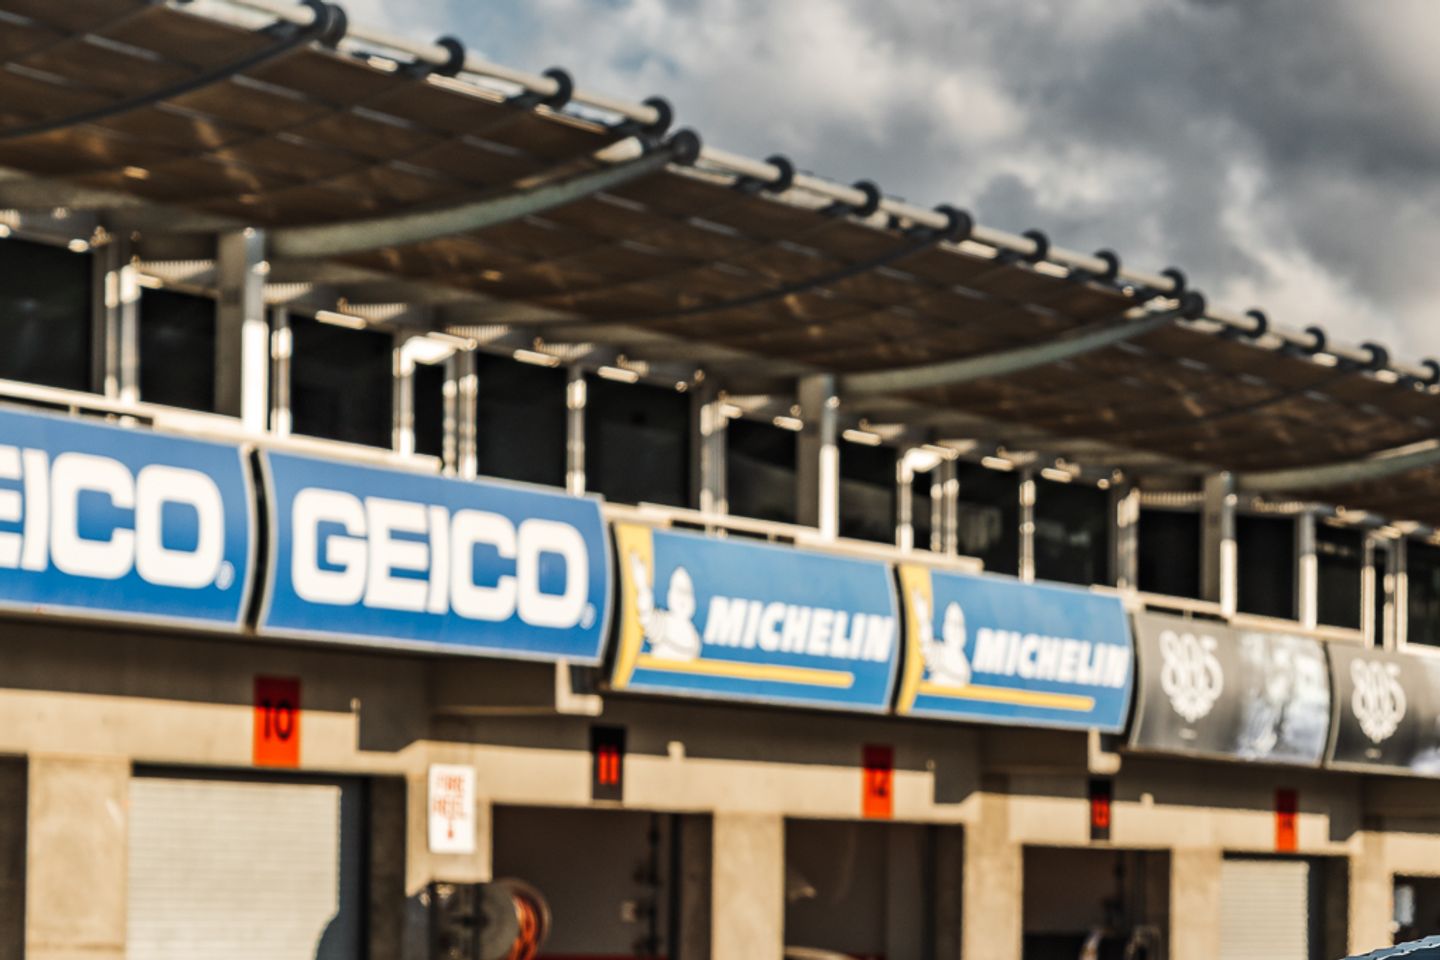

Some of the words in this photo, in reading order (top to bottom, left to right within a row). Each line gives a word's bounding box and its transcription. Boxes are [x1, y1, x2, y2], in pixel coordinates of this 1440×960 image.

[291, 487, 589, 628] GEICO
[703, 595, 896, 663] MICHELIN
[972, 627, 1129, 689] MICHELIN
[263, 699, 294, 741] 10
